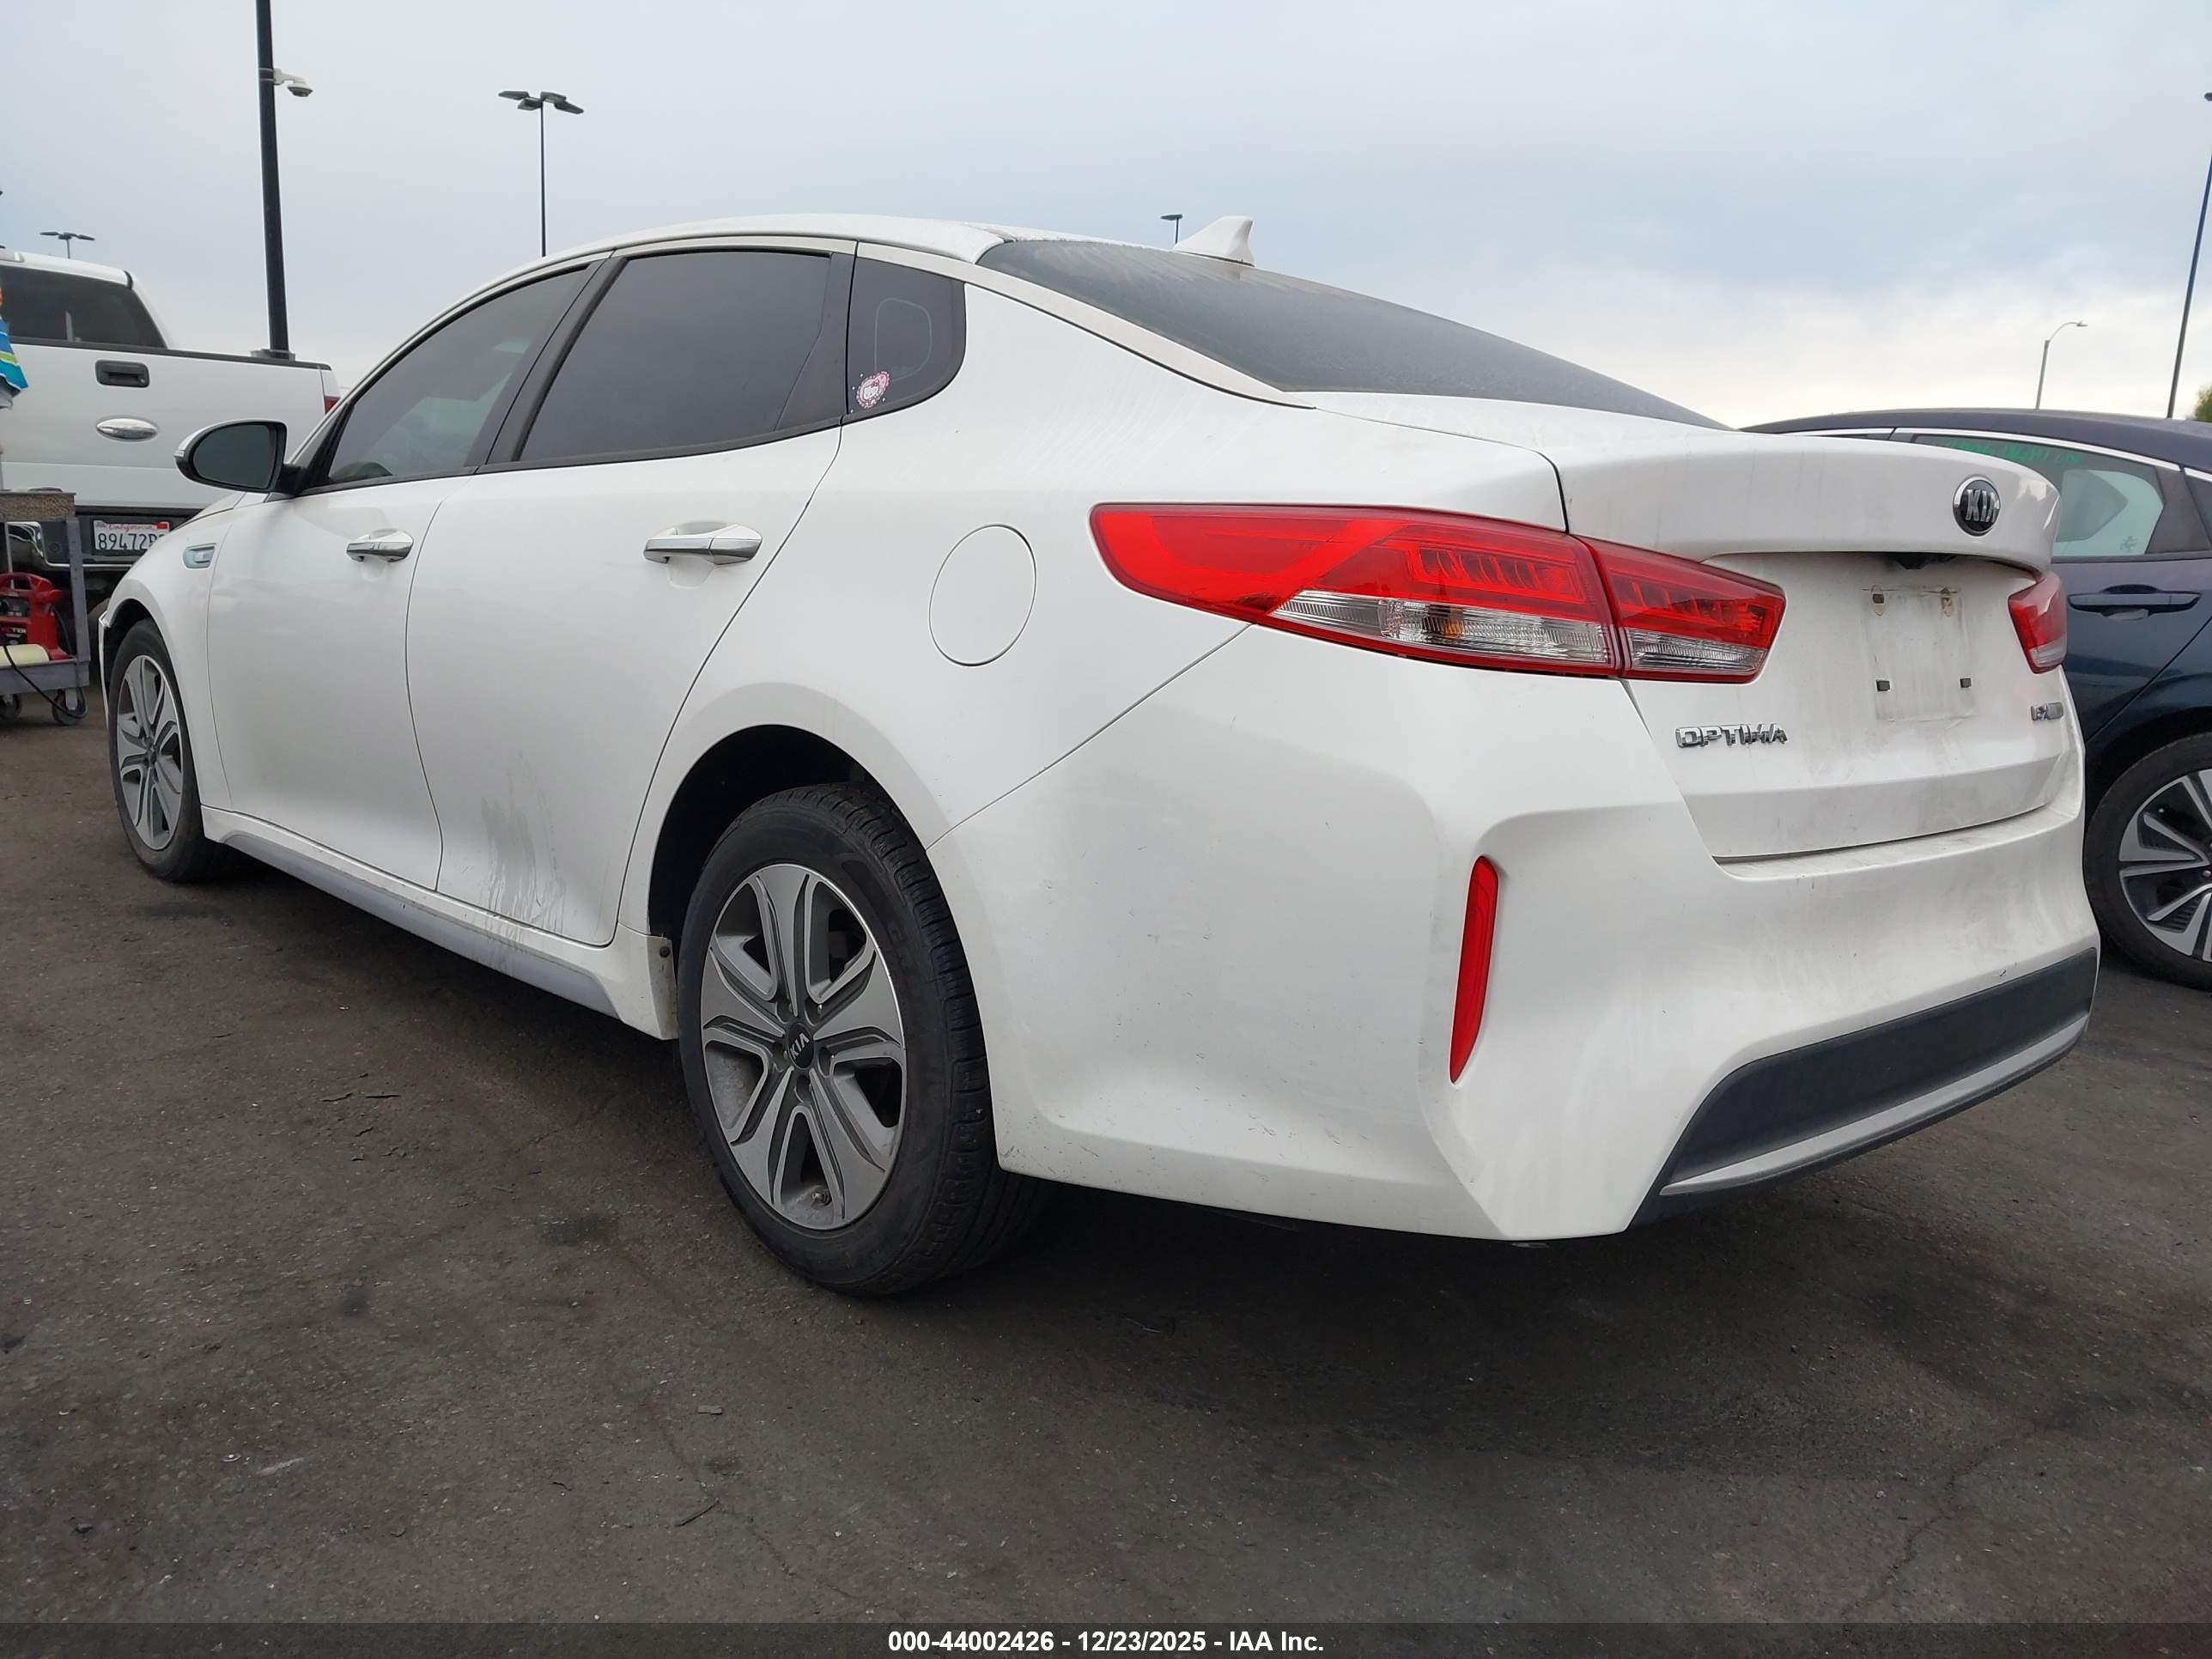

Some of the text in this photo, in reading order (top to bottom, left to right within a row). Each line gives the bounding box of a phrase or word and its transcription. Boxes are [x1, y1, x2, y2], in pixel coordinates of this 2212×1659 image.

[98, 532, 165, 550] 89472
[1675, 724, 1788, 748] OPTIMA
[790, 1032, 810, 1060] KIA
